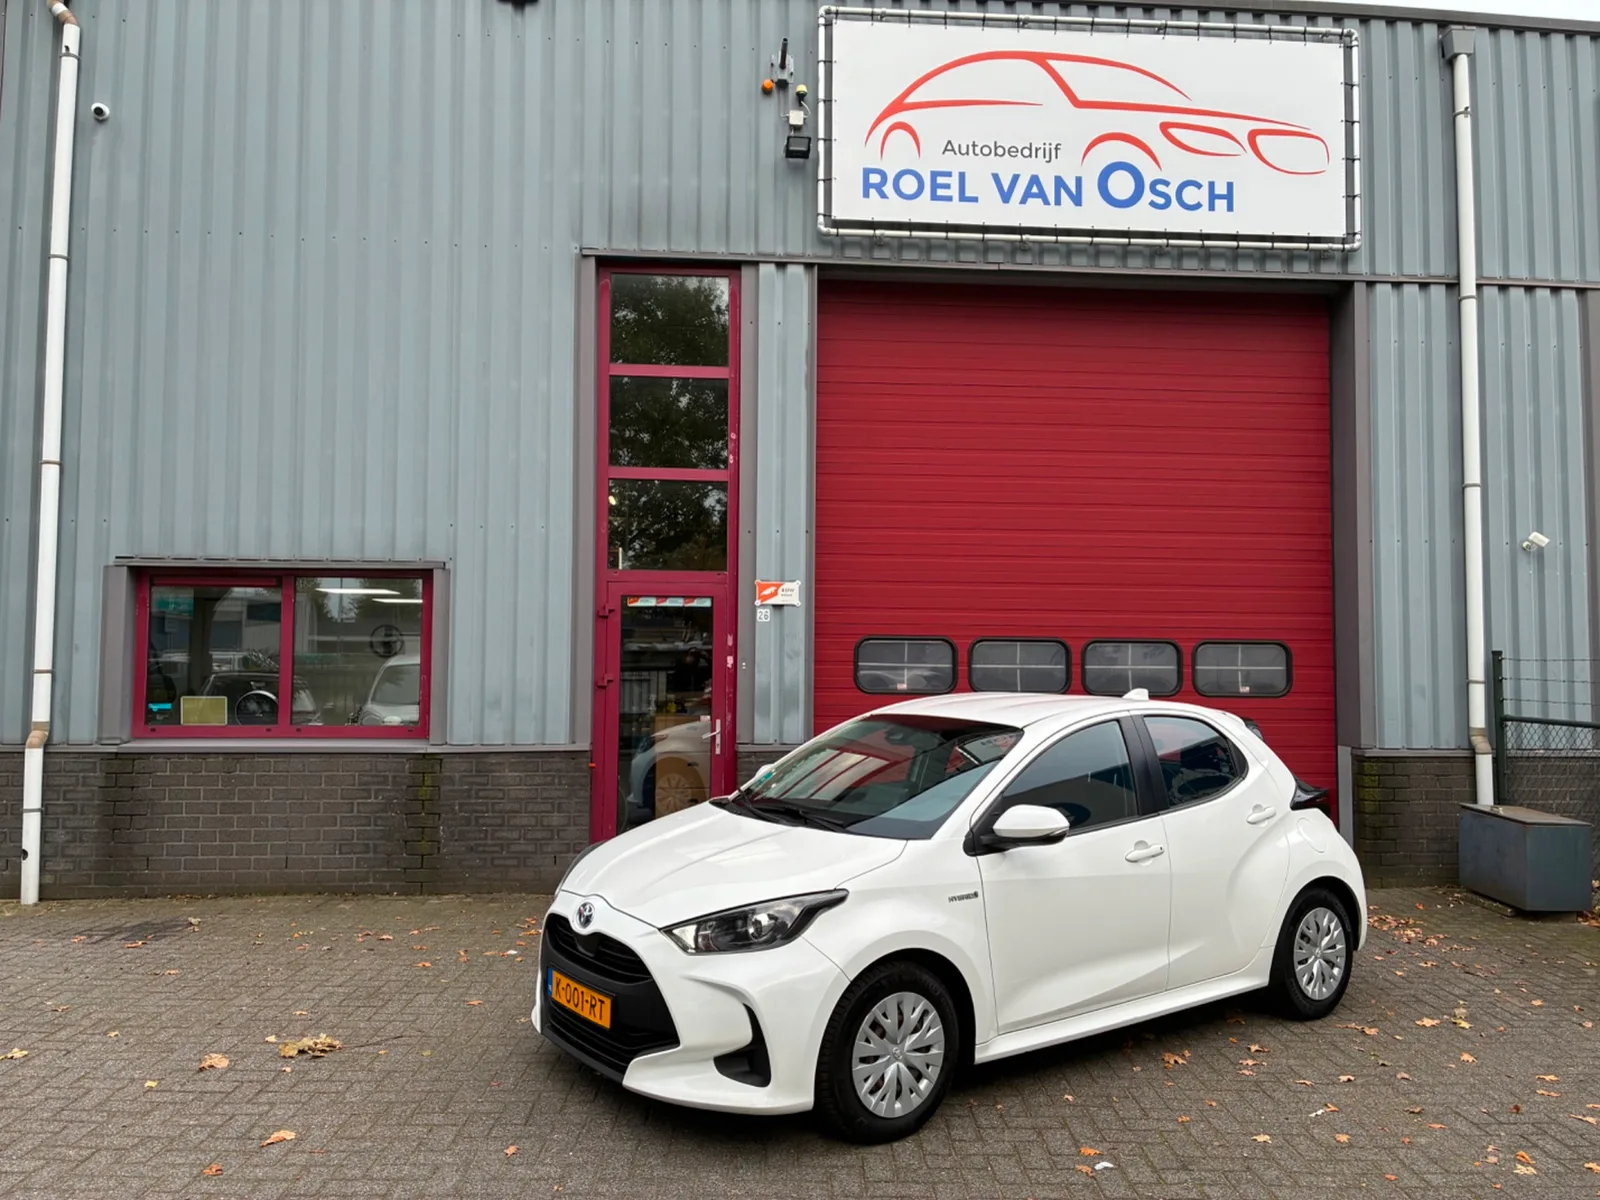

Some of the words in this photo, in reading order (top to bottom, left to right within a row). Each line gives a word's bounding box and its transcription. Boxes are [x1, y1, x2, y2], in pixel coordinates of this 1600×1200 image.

[942, 139, 1062, 164] Autobedrijf
[862, 167, 980, 204] ROEL
[991, 172, 1084, 208] VAN
[1097, 160, 1235, 213] OSCH
[758, 610, 769, 621] 26
[555, 976, 606, 1021] K-001-RT
